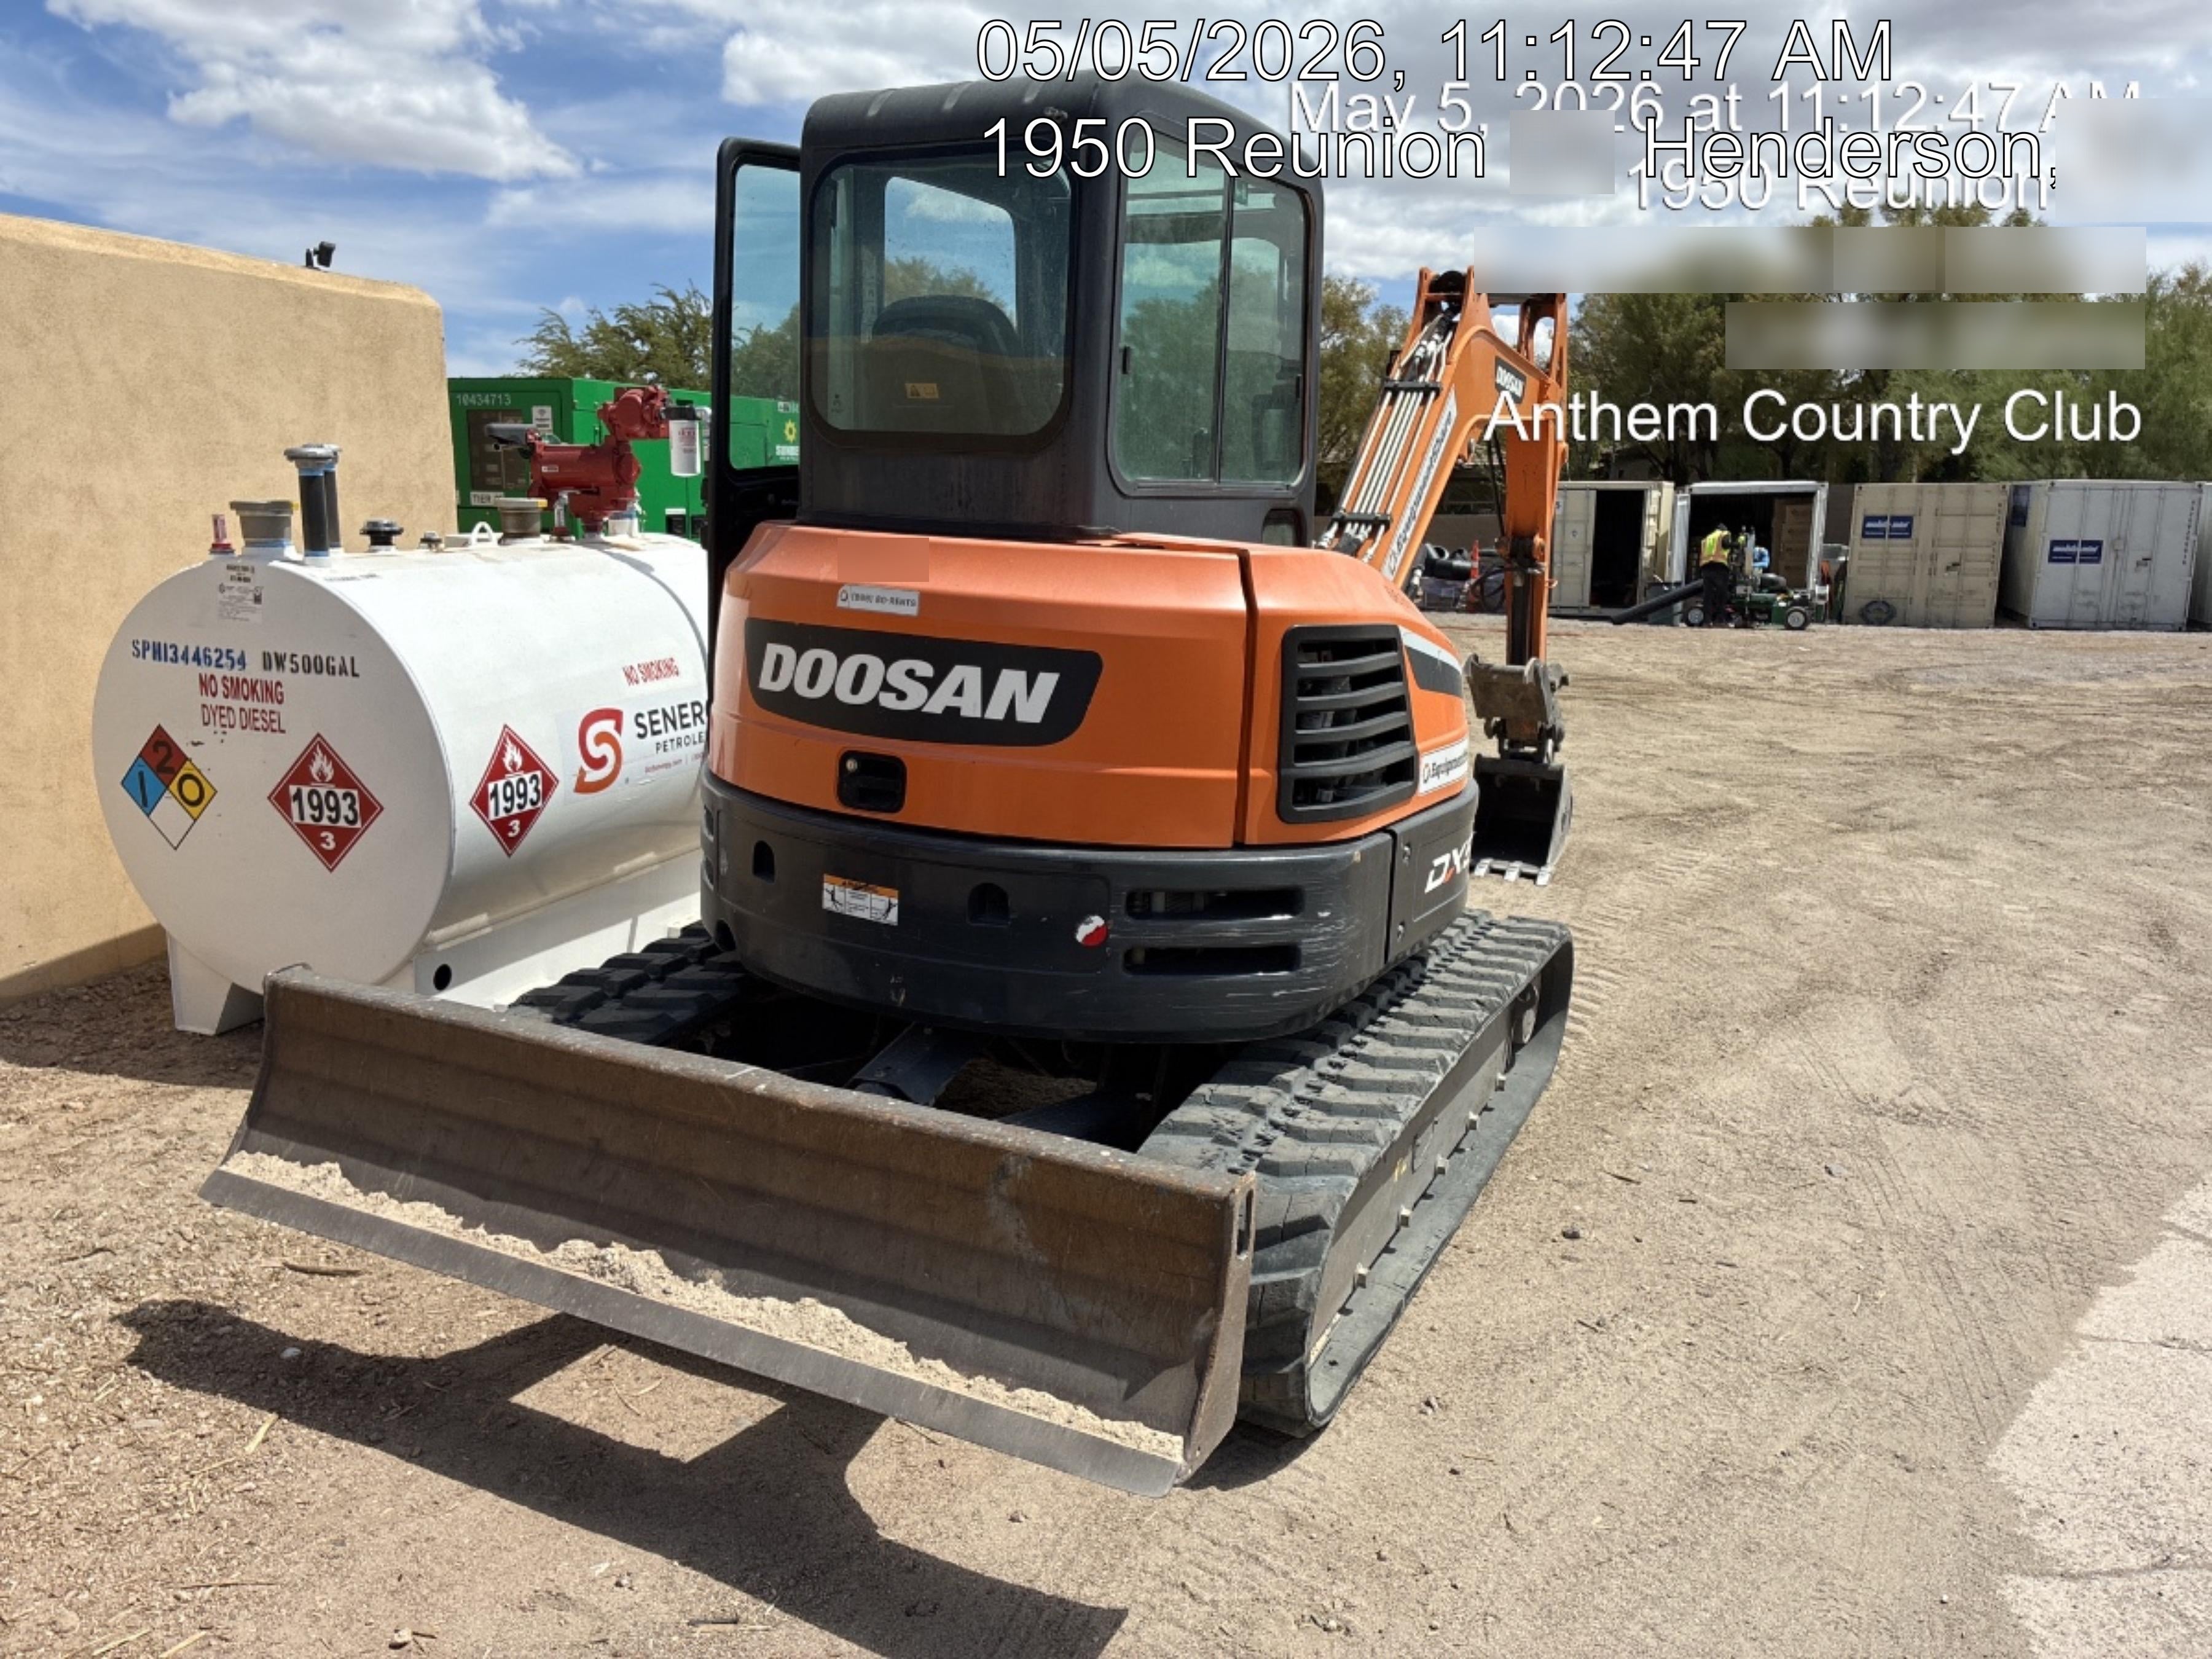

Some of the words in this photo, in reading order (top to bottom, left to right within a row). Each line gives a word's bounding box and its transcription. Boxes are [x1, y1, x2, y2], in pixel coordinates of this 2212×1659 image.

[198, 673, 218, 697] NO
[222, 676, 284, 705] SMOKING
[622, 665, 640, 686] NO
[758, 642, 1061, 723] DOOSAN
[201, 704, 235, 729] DYED
[239, 707, 286, 734] DIESEL
[634, 700, 707, 739] SENER
[152, 740, 175, 774] 2
[655, 731, 706, 755] PETROLE
[292, 787, 359, 827] 1993
[490, 774, 540, 817] 1993
[321, 831, 336, 850] 3
[508, 819, 520, 837] 3
